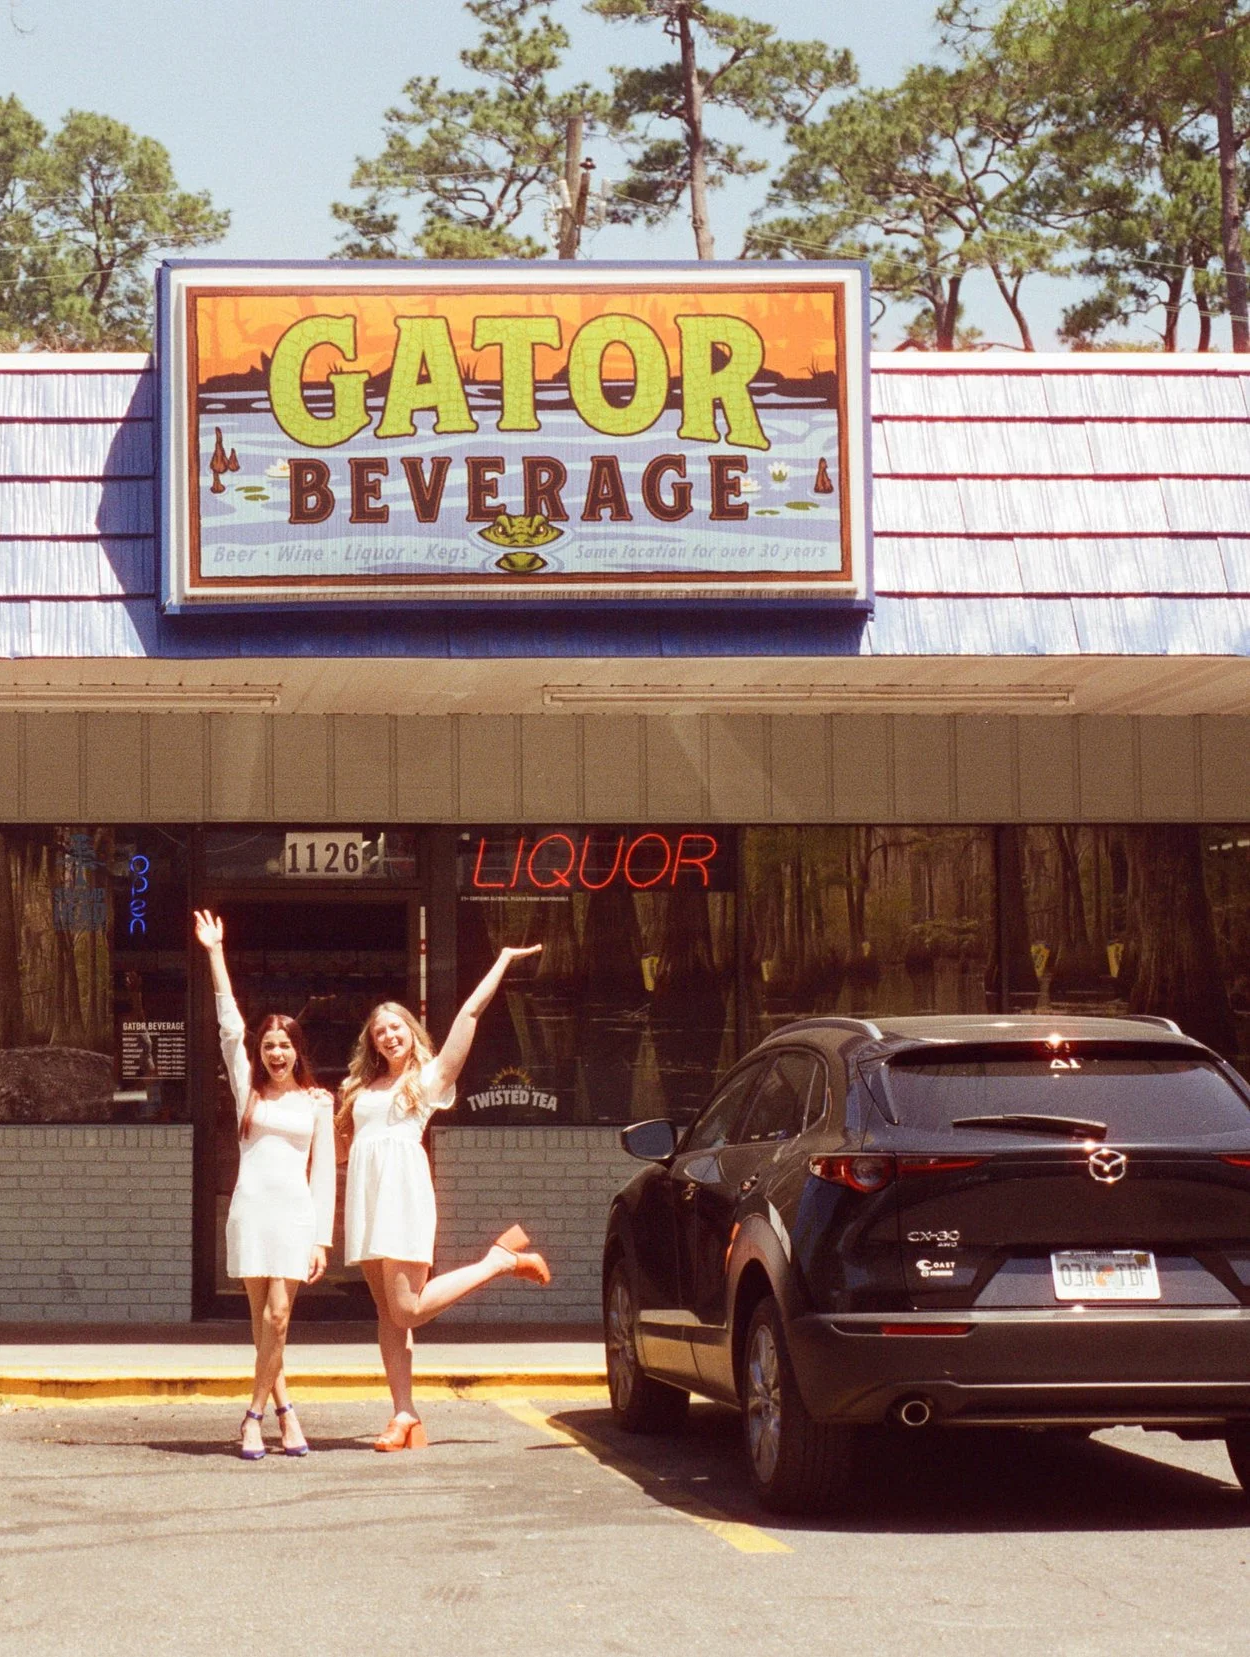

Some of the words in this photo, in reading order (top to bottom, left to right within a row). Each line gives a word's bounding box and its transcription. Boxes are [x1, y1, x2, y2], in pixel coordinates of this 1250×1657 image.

[268, 313, 770, 451] GATOR
[289, 455, 749, 525] BEVERAGE
[213, 546, 255, 563] Beer
[277, 545, 323, 562] Wine
[344, 544, 404, 565] Liquor
[425, 544, 469, 563] Kegs
[575, 544, 617, 559] Same
[623, 543, 686, 559] location
[691, 543, 713, 559] for
[721, 545, 754, 558] over
[759, 543, 780, 557] 30
[783, 544, 827, 561] years
[288, 842, 359, 873] 1126
[473, 833, 717, 889] LIQUOR
[122, 1022, 146, 1030] GATOR
[148, 1022, 185, 1030] BEVERAGE
[467, 1090, 530, 1111] TWISTED
[532, 1091, 558, 1111] TEA
[907, 1230, 960, 1241] CX-30
[916, 1259, 956, 1270] COAST
